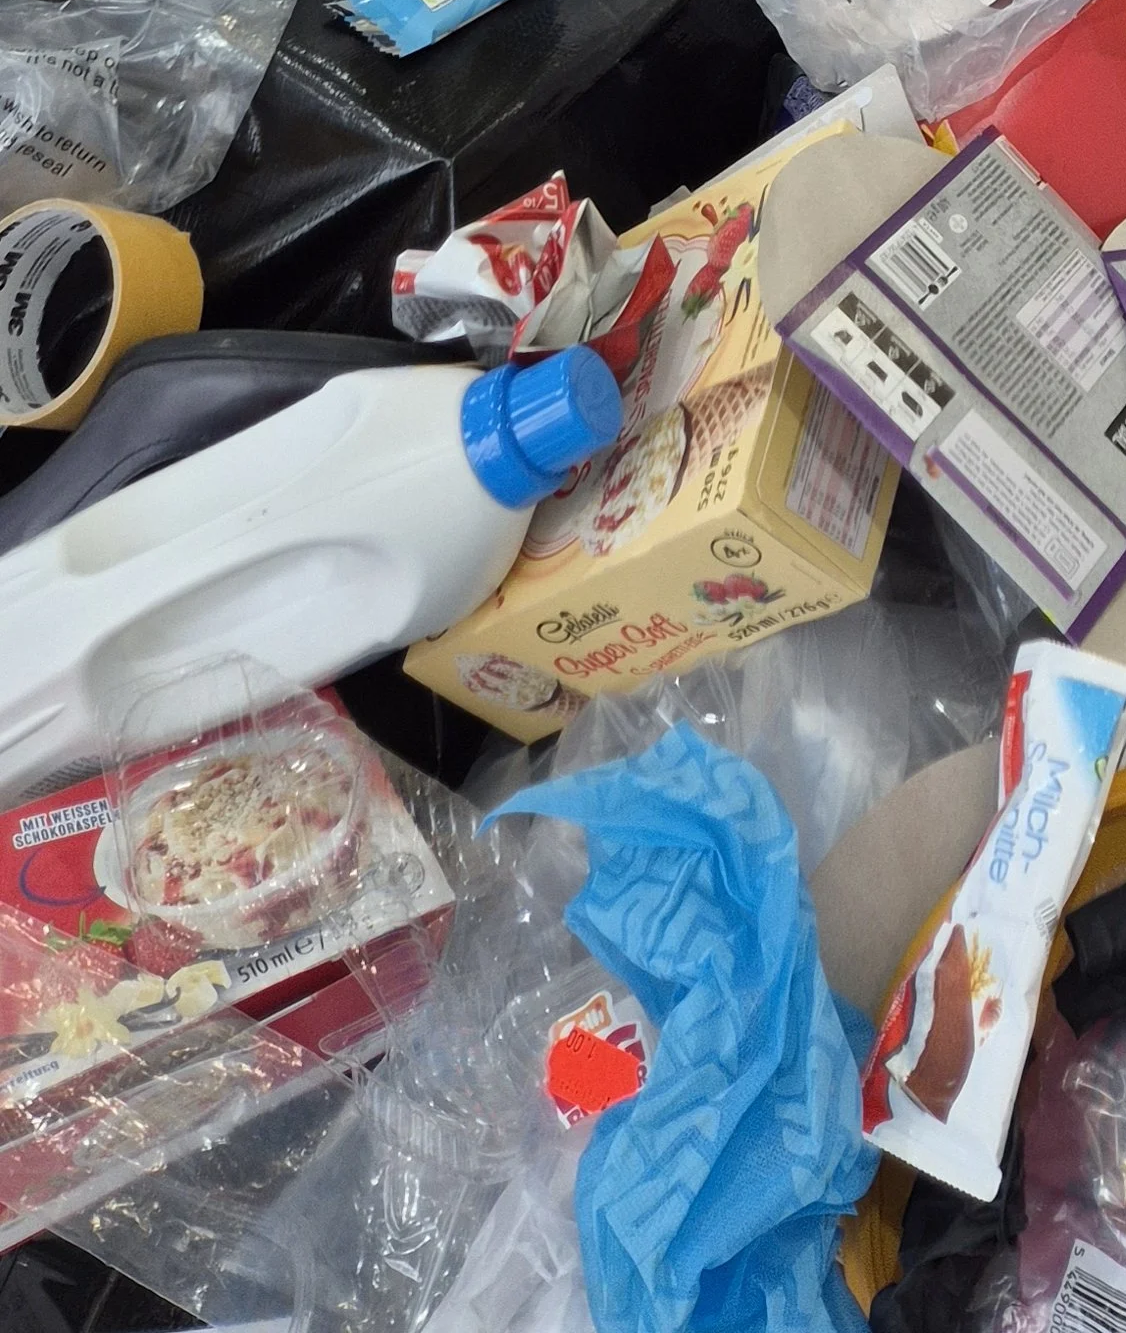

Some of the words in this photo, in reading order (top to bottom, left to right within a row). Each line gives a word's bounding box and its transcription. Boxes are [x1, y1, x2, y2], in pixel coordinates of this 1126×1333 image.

[61, 58, 91, 81] not
[15, 141, 73, 179] reseal
[54, 134, 108, 174] return
[7, 291, 33, 337] 3M
[536, 602, 622, 645] Gelatelli
[553, 638, 638, 679] Super
[620, 611, 689, 648] Soft
[21, 817, 48, 832] MIT
[50, 799, 109, 825] WEISSEN
[1021, 755, 1072, 875] Milch-
[236, 955, 269, 984] 510
[270, 944, 293, 969] ml
